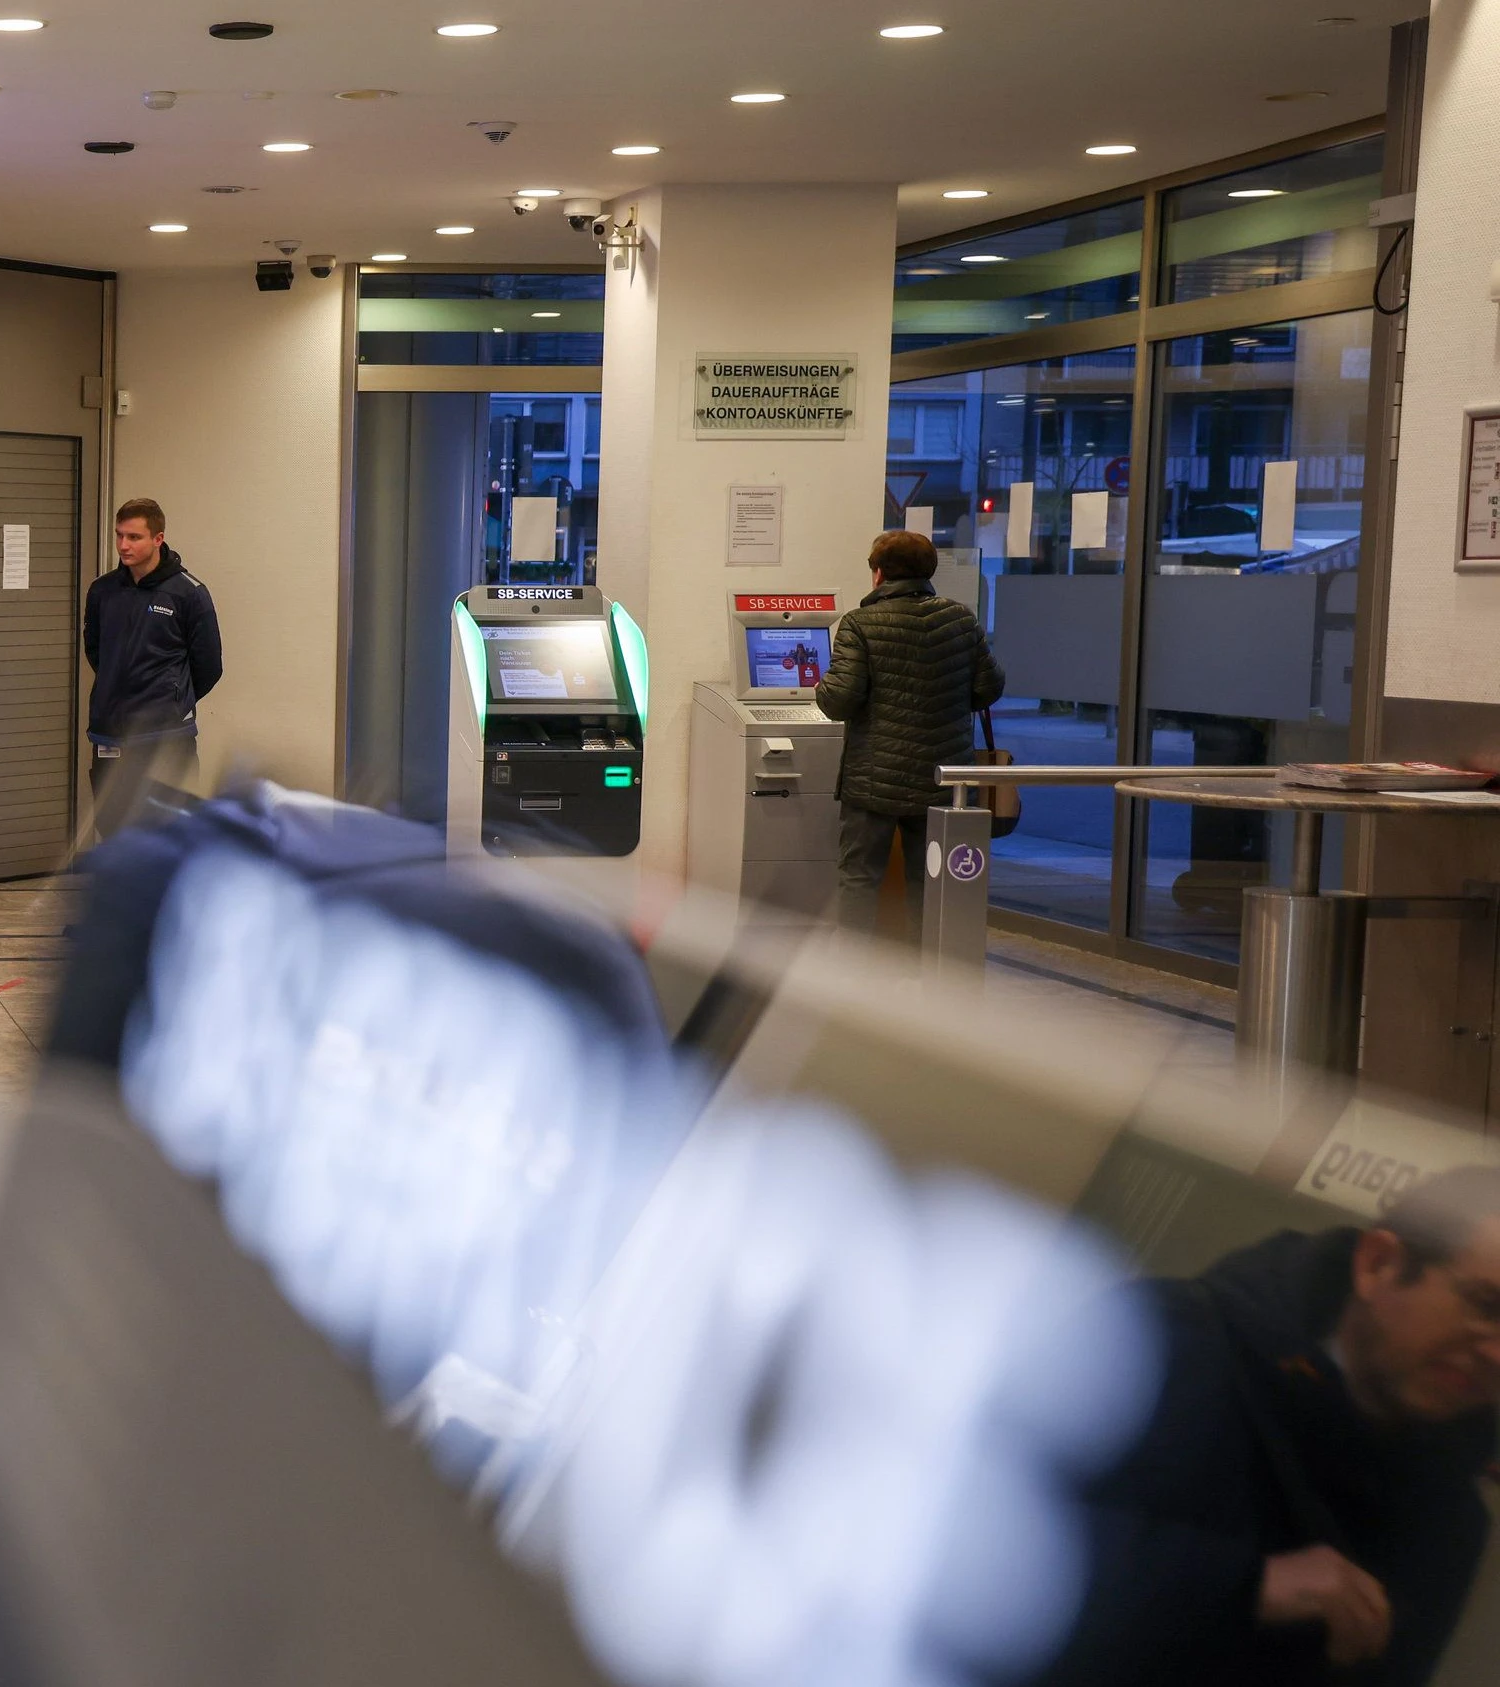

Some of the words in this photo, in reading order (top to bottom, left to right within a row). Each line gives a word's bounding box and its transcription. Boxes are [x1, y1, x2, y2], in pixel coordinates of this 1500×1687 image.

[713, 362, 839, 377] ÜBERWEISUNGEN
[711, 384, 839, 398] DAUERAUFTRÄGE
[706, 405, 844, 420] KONTOAUSKÜNFTE
[497, 588, 573, 599] SB-SERVICE
[749, 598, 822, 609] SB-SERVICE
